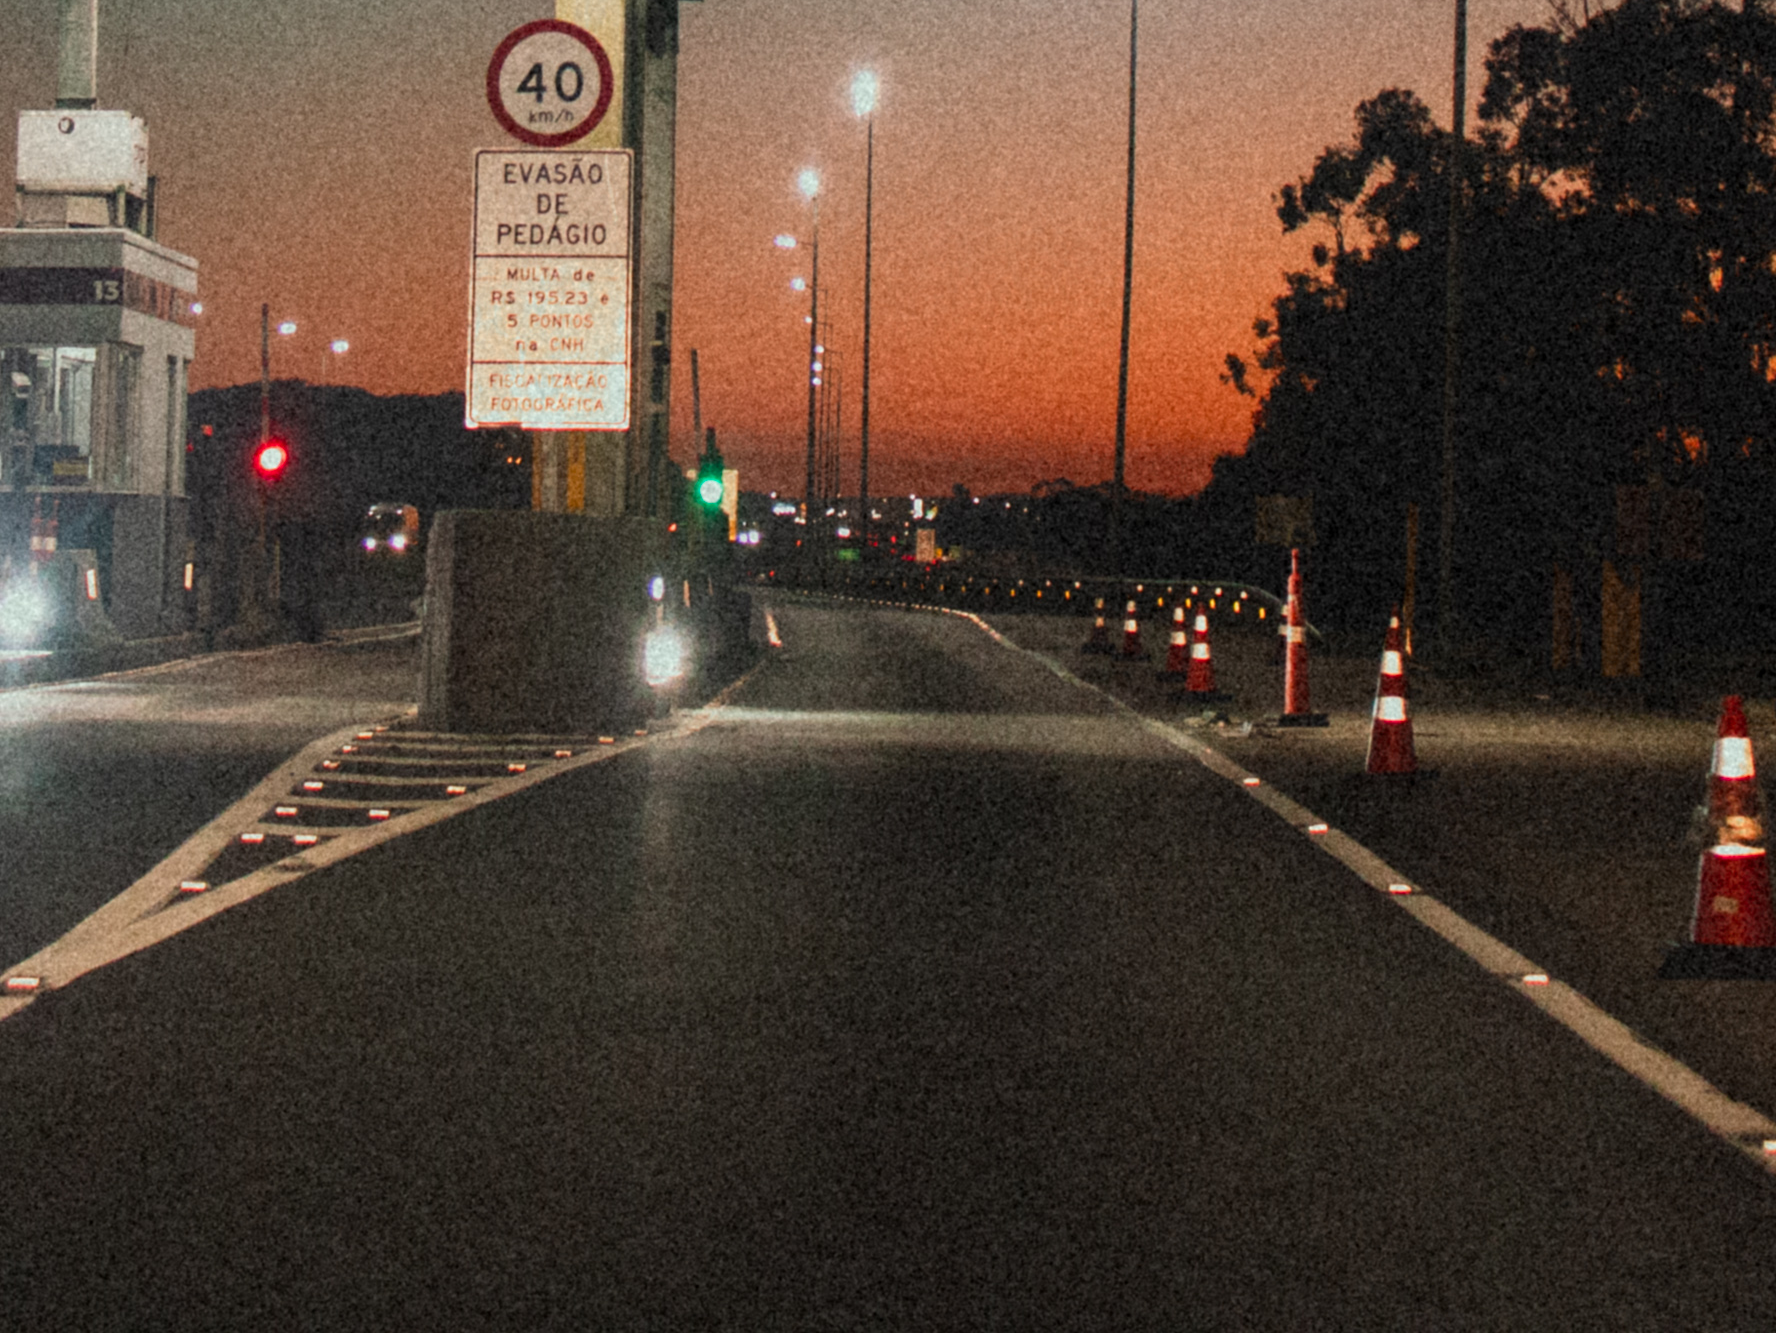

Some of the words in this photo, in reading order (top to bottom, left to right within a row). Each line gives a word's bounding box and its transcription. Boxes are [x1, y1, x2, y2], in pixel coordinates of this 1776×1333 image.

[516, 61, 584, 103] 40
[528, 108, 575, 124] km/h
[503, 157, 604, 185] EVASÃO
[536, 193, 568, 215] DE
[496, 215, 607, 246] PEDÁGIO
[507, 267, 560, 282] MULTA
[573, 268, 595, 282] de
[93, 280, 119, 300] 13
[491, 291, 516, 305] R$
[507, 314, 518, 328] 5
[529, 314, 594, 329] PONTOS
[515, 339, 538, 352] na
[550, 337, 584, 352] CNH
